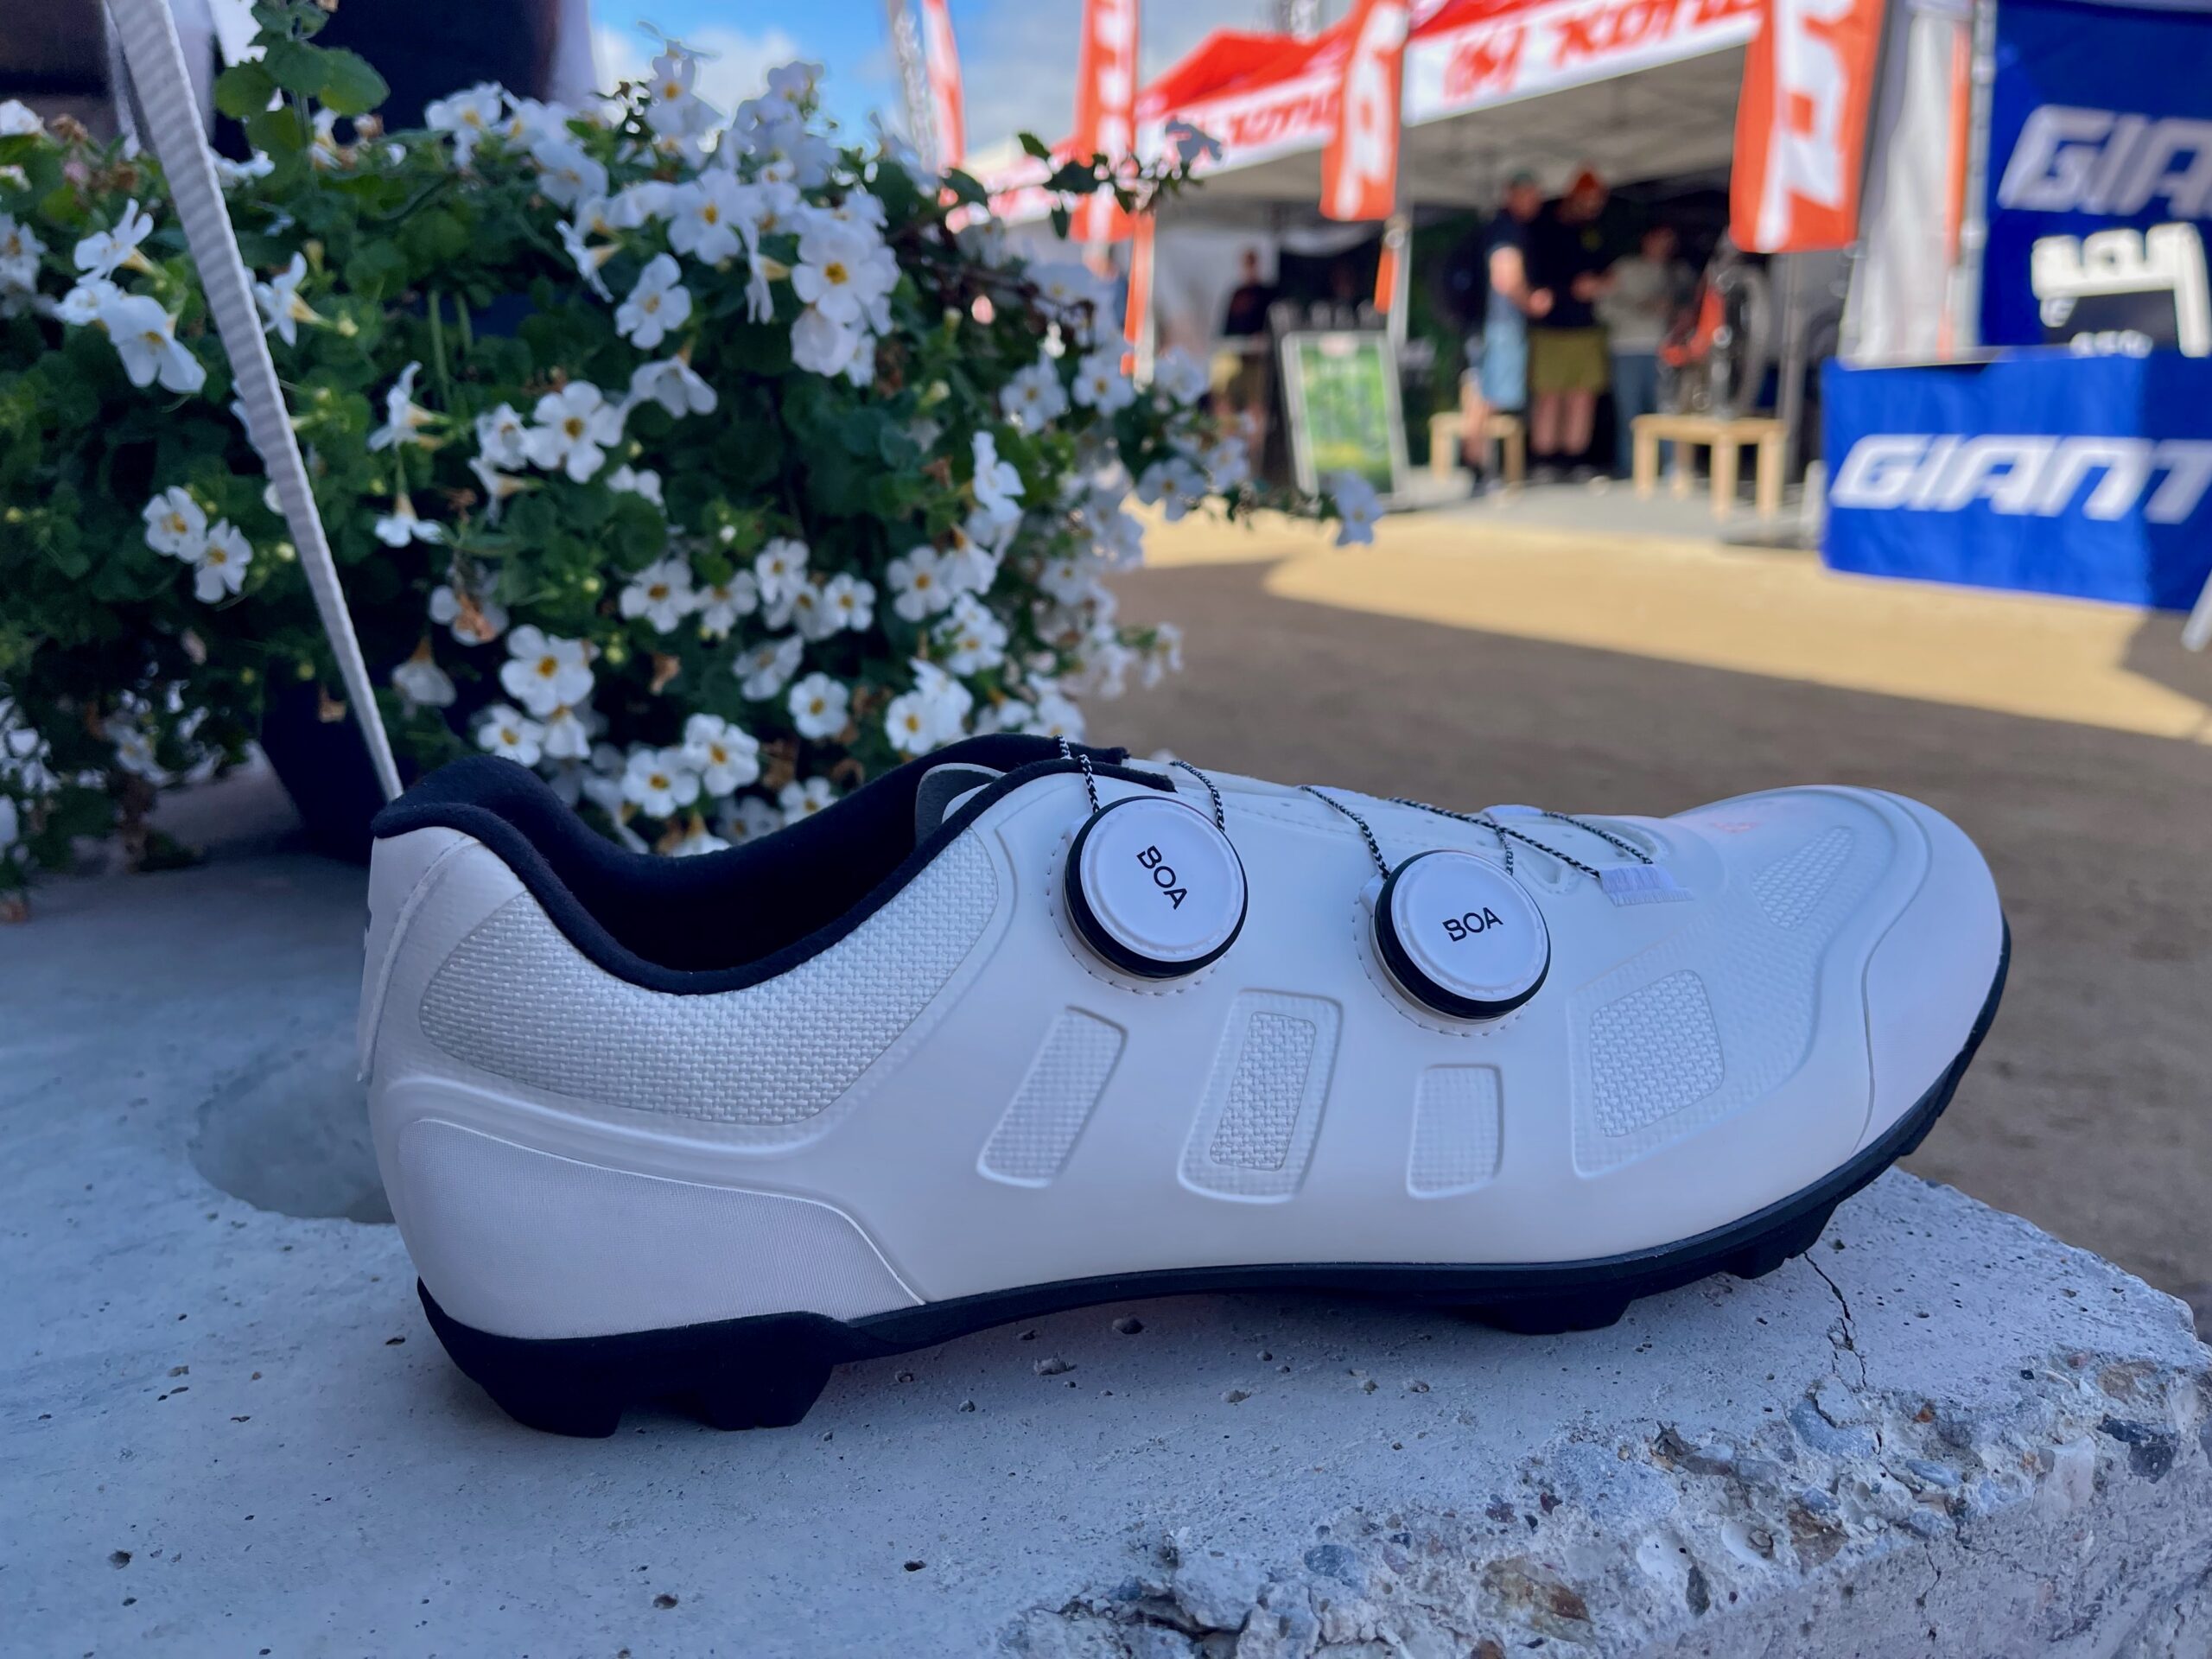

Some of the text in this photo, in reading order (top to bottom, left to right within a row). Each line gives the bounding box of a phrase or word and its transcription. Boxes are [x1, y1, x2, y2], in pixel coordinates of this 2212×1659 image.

[1829, 434, 2212, 524] GIANT
[1136, 845, 1187, 910] BOA
[1442, 907, 1503, 942] BOA
